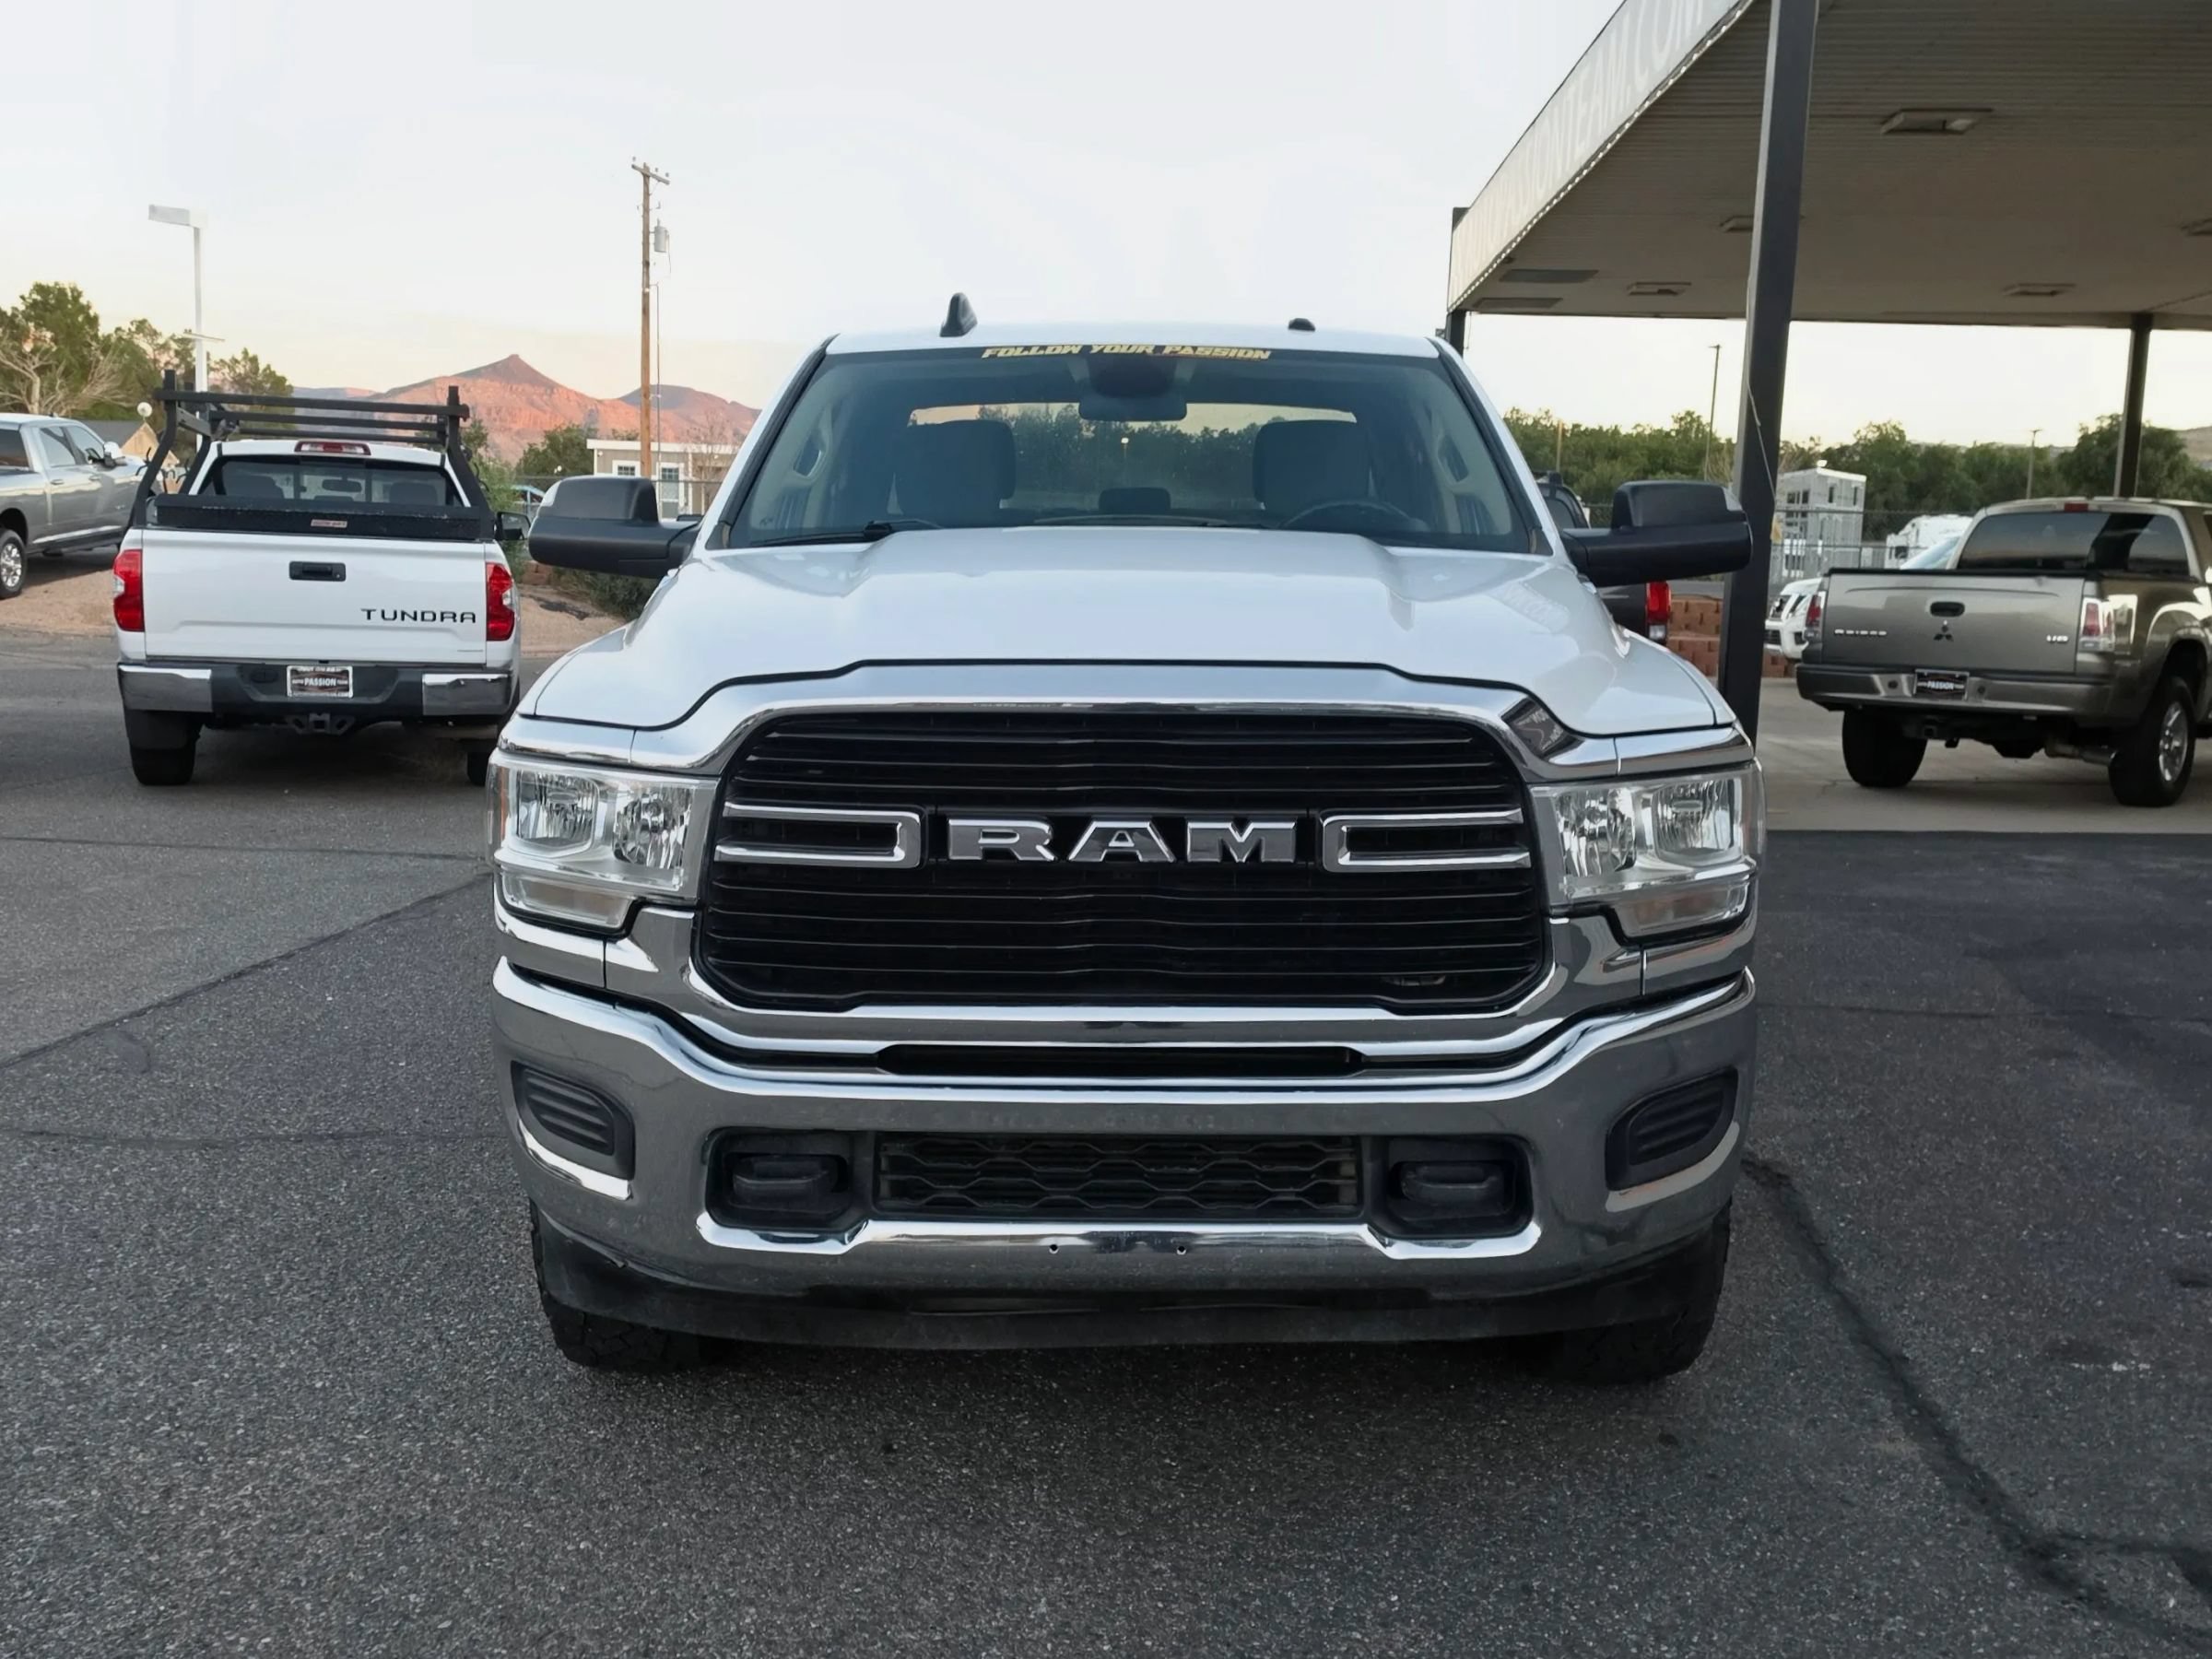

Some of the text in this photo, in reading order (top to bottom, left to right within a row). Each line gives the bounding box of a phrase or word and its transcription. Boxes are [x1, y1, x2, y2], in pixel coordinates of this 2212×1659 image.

[981, 343, 1272, 360] FOLLOW YOUR PASSION
[360, 608, 477, 624] TUNDRA
[304, 677, 336, 687] PASSION
[947, 817, 1297, 863] RAM
